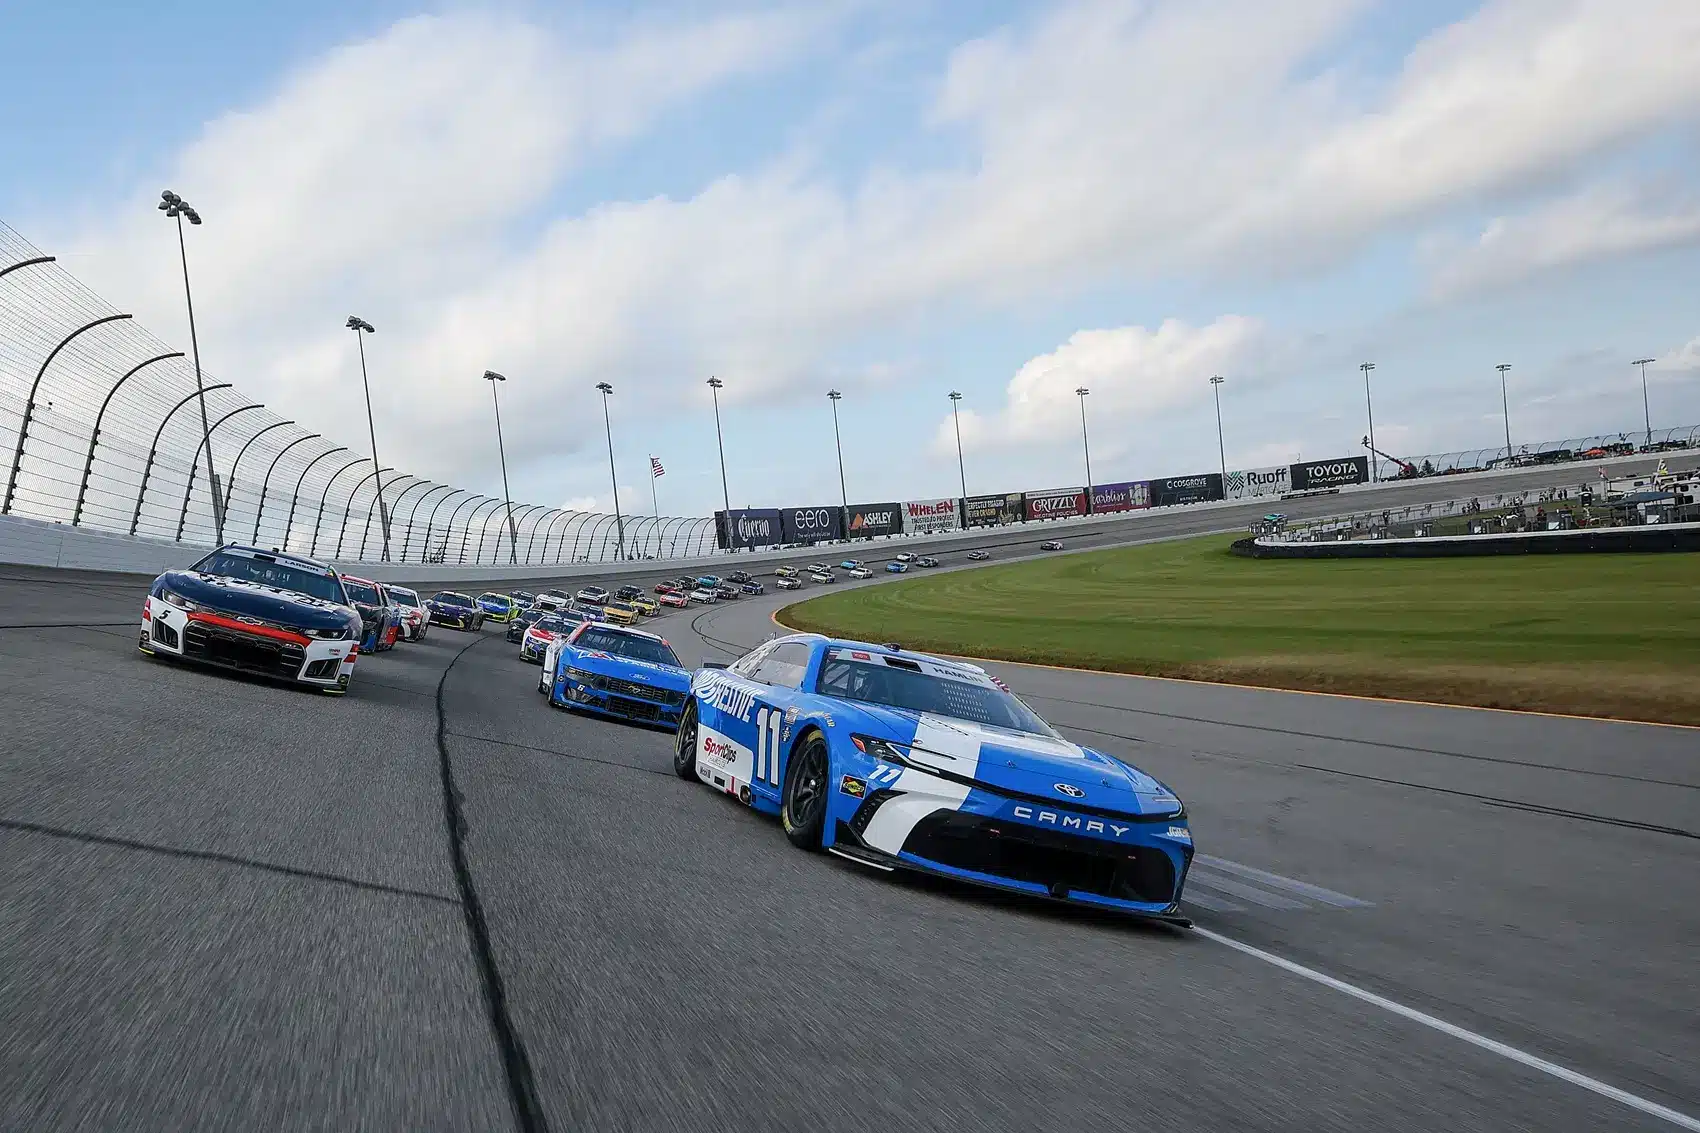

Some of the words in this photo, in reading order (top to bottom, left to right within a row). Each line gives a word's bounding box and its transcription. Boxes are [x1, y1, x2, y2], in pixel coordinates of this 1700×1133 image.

[1247, 468, 1287, 486] Ruoff
[1306, 462, 1358, 478] TOYOTA
[1173, 477, 1207, 488] COSGROVE
[1308, 474, 1358, 484] RACING
[907, 499, 954, 516] WHELEN
[1032, 495, 1078, 513] GRIZZLY
[795, 509, 830, 529] eero
[863, 511, 893, 526] ASHLEY
[738, 513, 770, 542] Cuervo
[284, 560, 319, 572] LARSON
[159, 610, 171, 619] 5
[932, 667, 984, 683] HAMLIN
[756, 706, 782, 786] 11
[867, 764, 902, 783] 11
[1013, 805, 1130, 837] CAMRY
